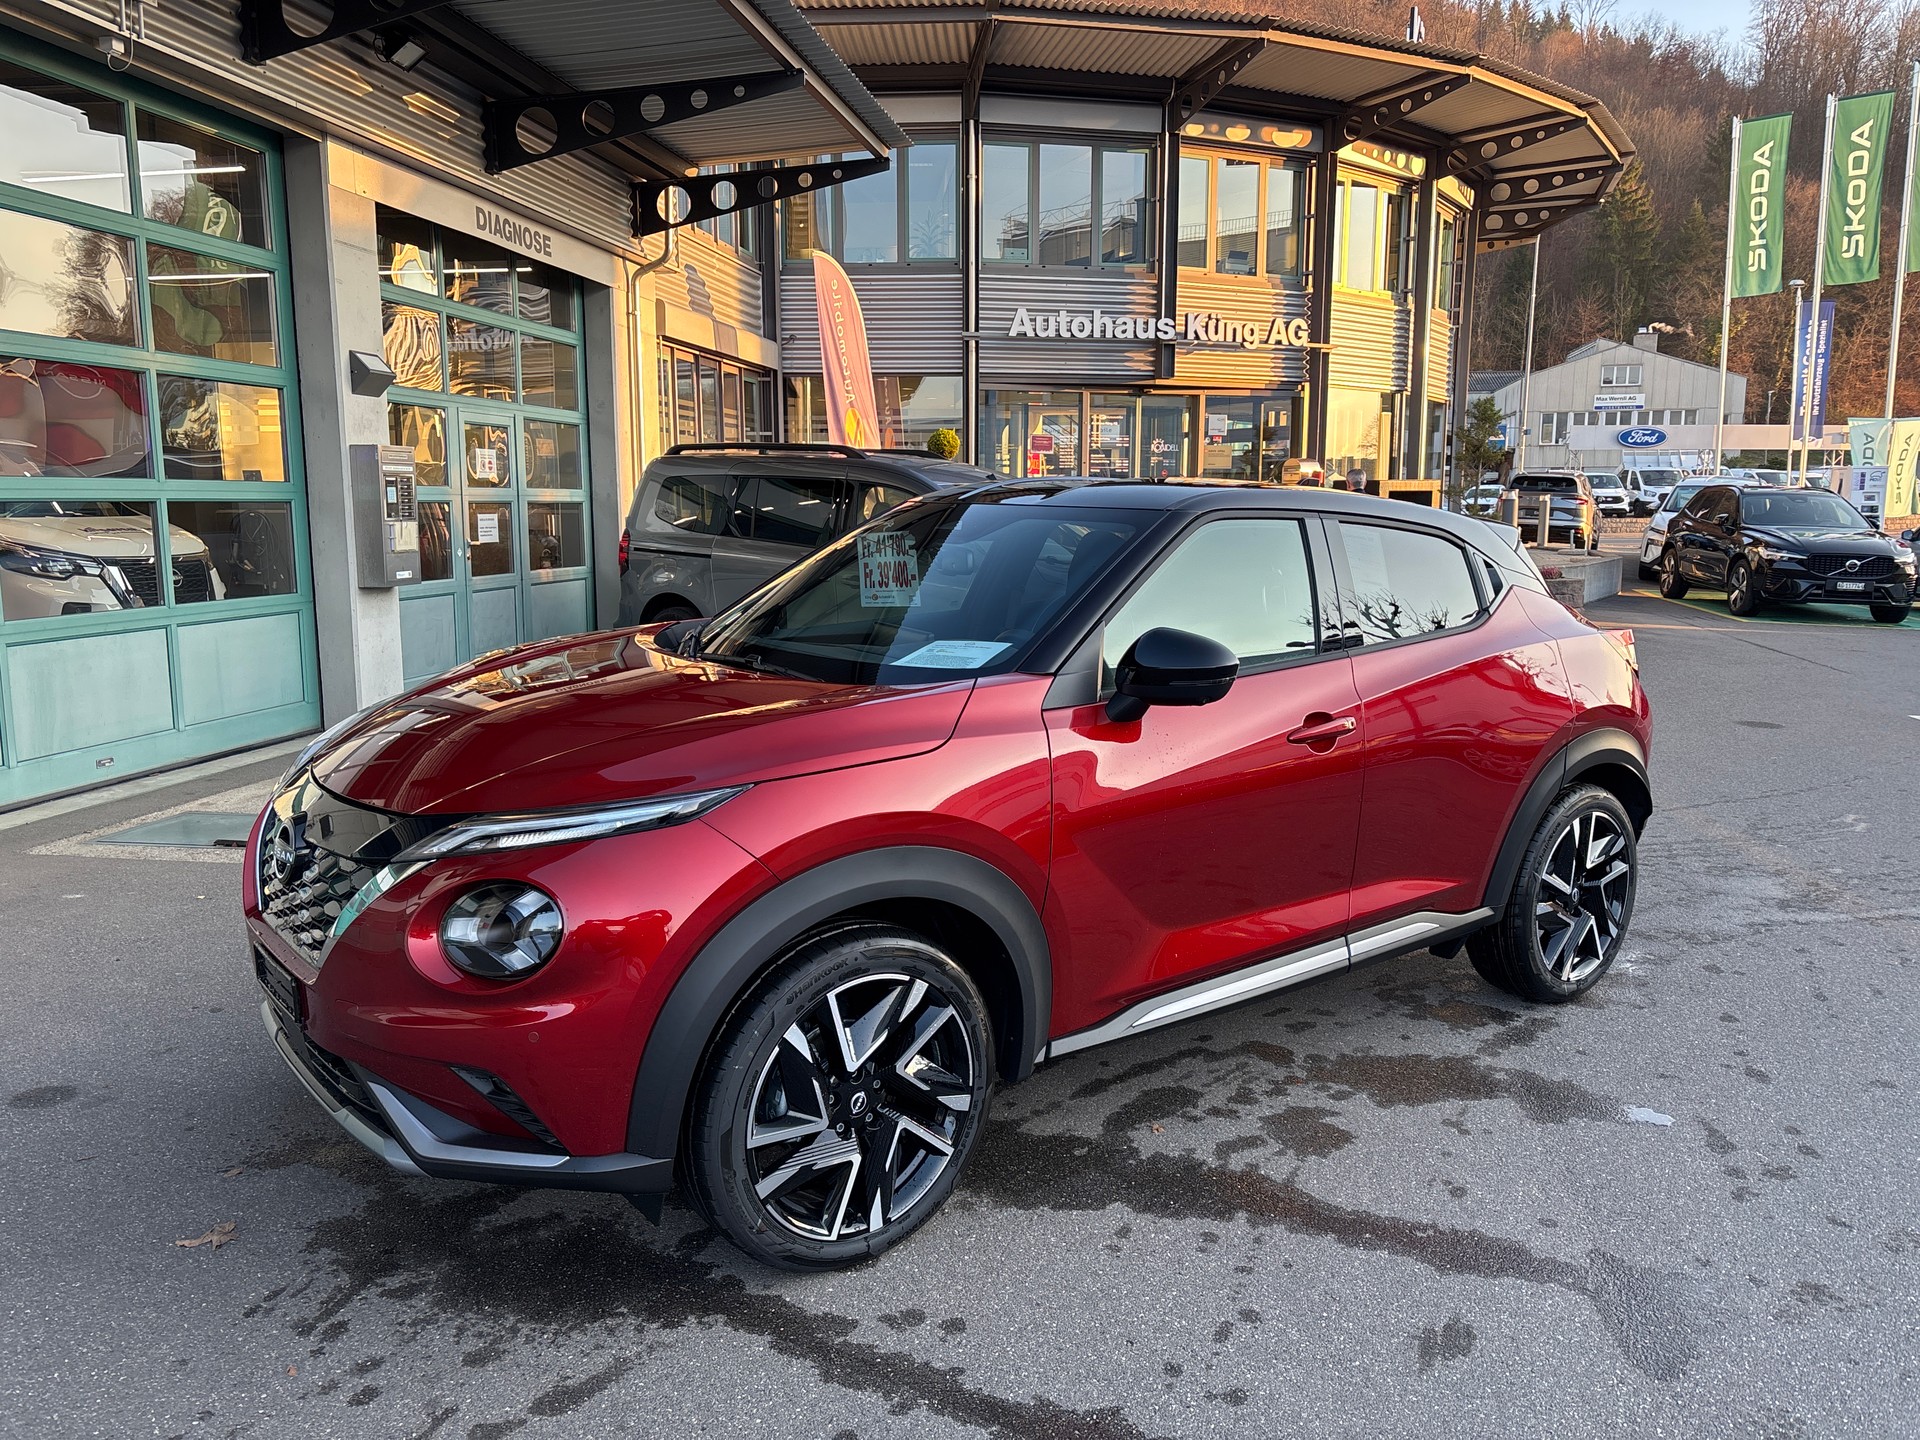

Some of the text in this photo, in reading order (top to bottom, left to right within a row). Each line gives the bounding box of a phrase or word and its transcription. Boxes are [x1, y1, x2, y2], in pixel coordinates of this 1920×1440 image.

[475, 205, 552, 257] DIAGNOSE
[1008, 308, 1310, 349] Autohaus Küng AG
[1628, 429, 1658, 443] Ford
[863, 562, 876, 589] Fr.
